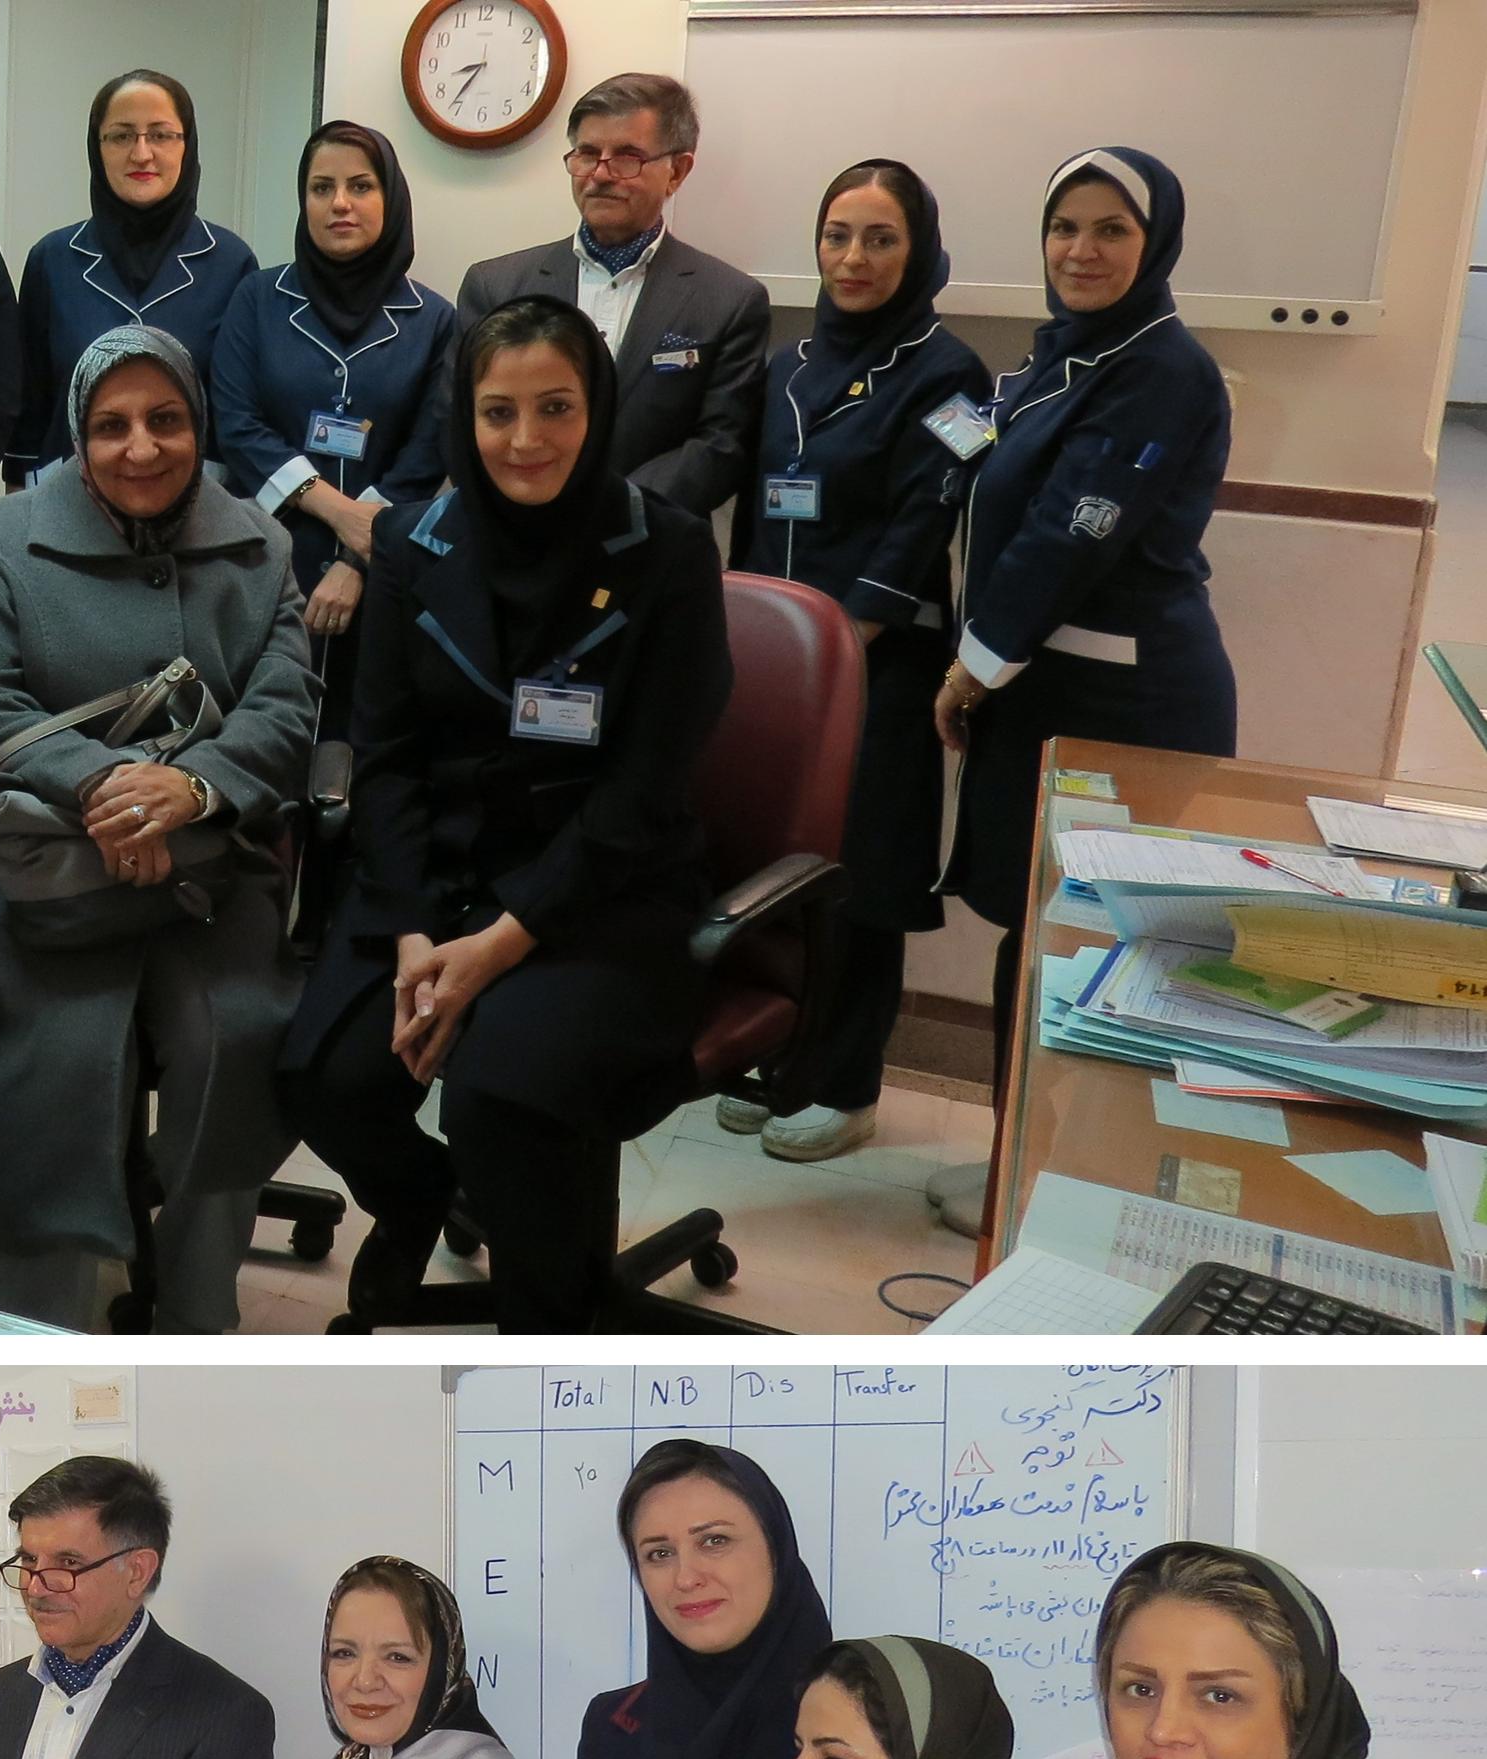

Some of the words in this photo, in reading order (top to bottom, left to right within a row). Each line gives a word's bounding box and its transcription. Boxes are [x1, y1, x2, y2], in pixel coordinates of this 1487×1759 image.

[454, 12, 467, 28] 11
[478, 4, 494, 21] 12
[507, 10, 513, 27] 1
[436, 32, 450, 48] 10
[522, 27, 533, 44] 2
[428, 57, 439, 74] 9
[435, 83, 446, 99] 8
[520, 81, 532, 97] 4
[453, 101, 463, 116] 7
[477, 106, 488, 123] 6
[502, 99, 513, 116] 5
[550, 1377, 609, 1409] Total
[650, 1377, 698, 1407] N.B
[736, 1371, 794, 1398] Dis
[836, 1367, 917, 1397] Transfer
[1021, 1432, 1075, 1473] توجه
[479, 1459, 514, 1495] M
[916, 1478, 1006, 1526] همکاران
[1010, 1483, 1075, 1516] خدمت
[486, 1558, 509, 1595] E
[477, 1654, 499, 1689] N
